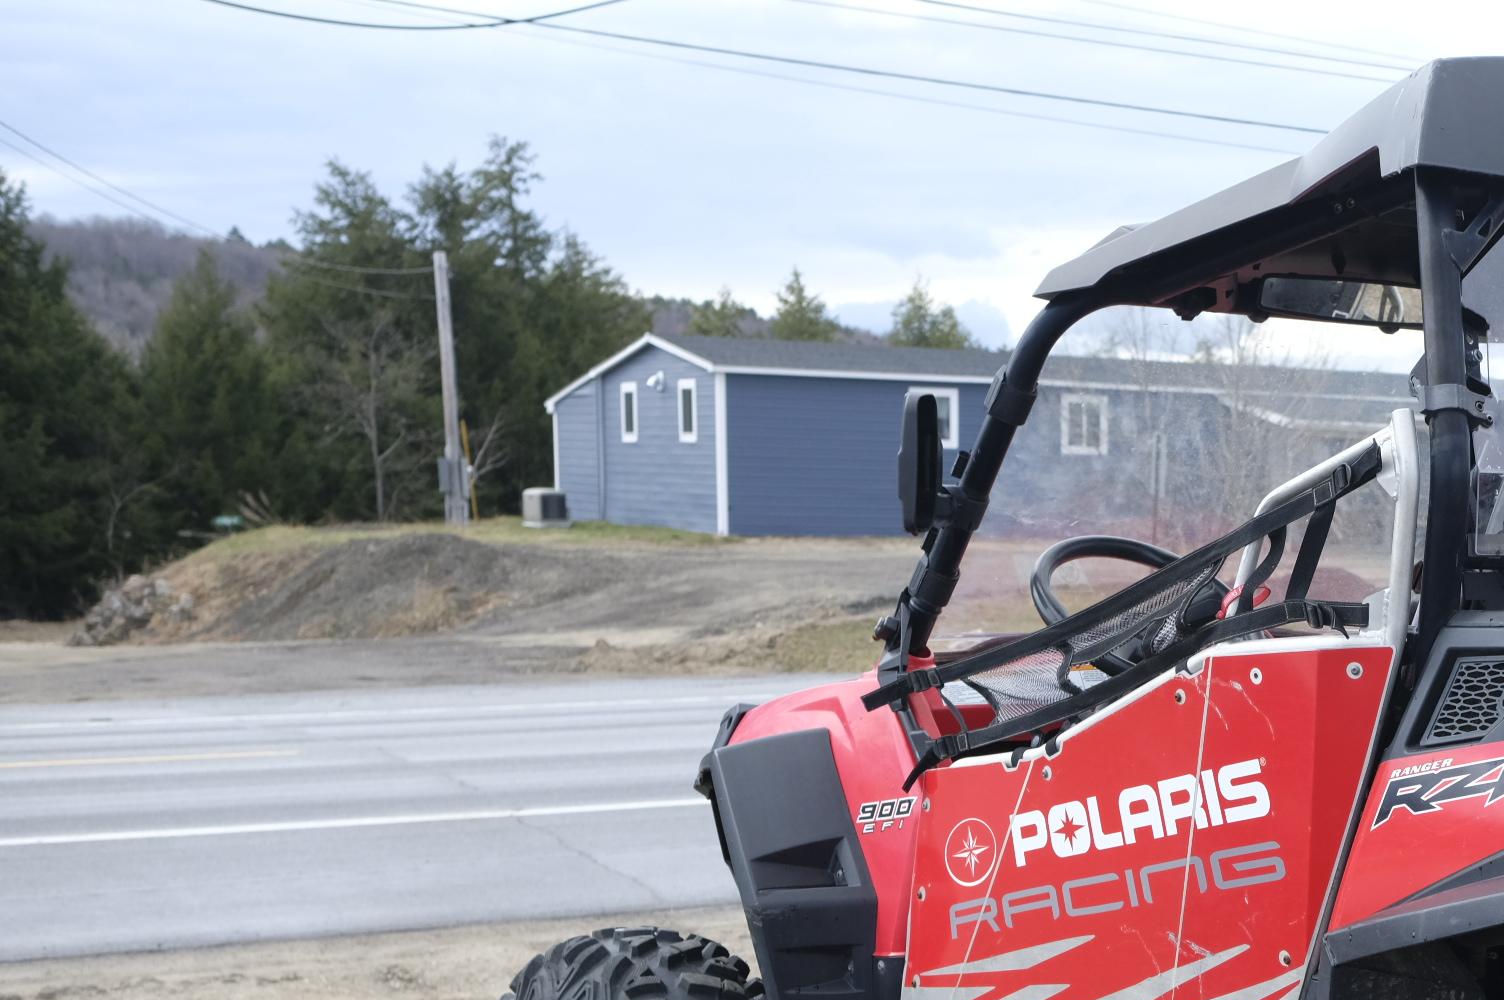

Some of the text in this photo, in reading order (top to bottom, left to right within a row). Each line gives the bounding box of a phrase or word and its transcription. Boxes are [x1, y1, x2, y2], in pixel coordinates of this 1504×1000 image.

[1390, 758, 1453, 778] RANGER
[856, 796, 918, 824] 900
[1011, 758, 1271, 868] POLARIS
[862, 820, 904, 834] EFI
[948, 841, 1286, 940] RACING
